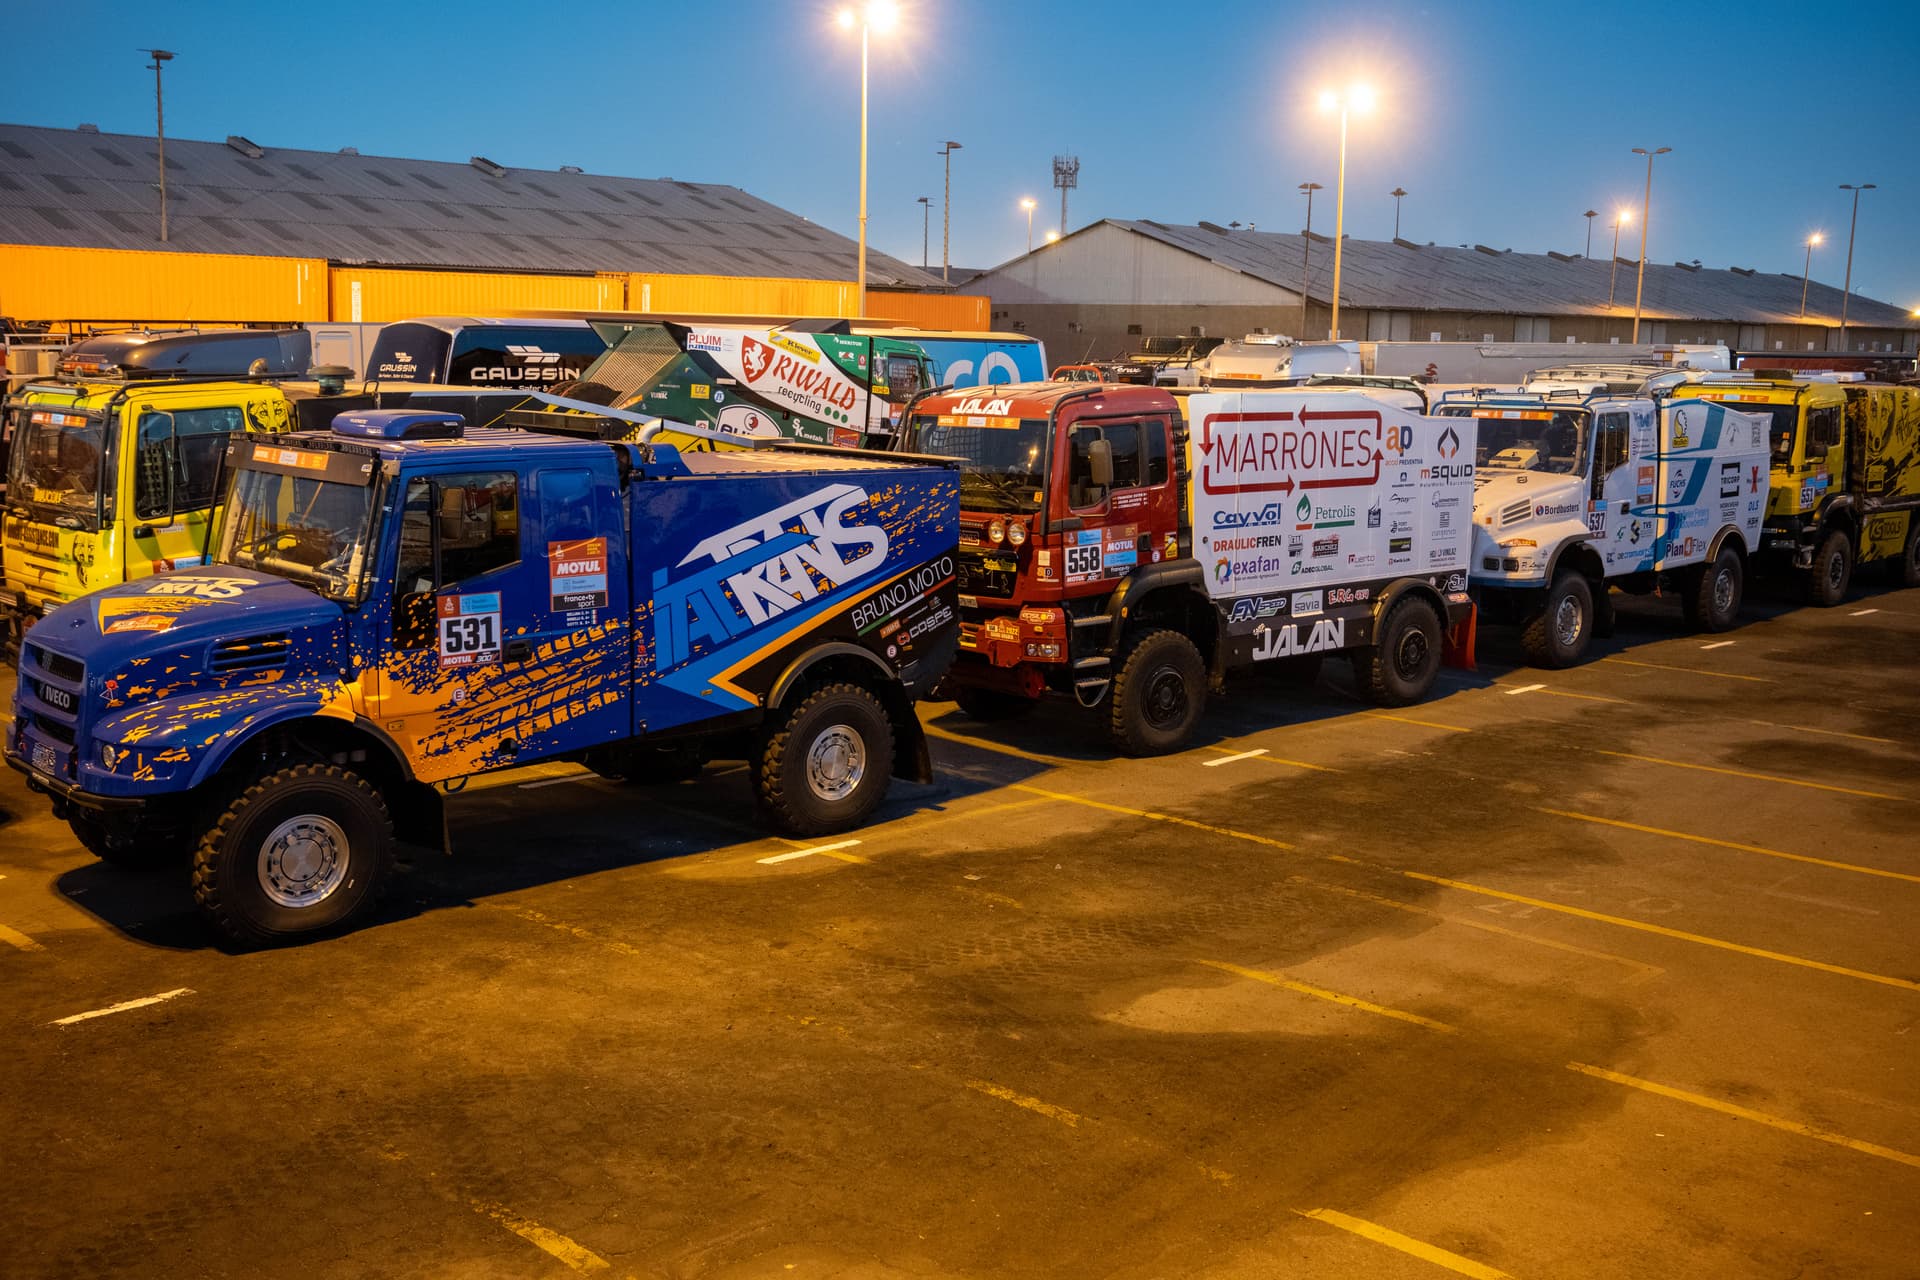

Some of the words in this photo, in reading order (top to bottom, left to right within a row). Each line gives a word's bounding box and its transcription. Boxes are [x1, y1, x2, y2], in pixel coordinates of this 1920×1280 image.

[689, 334, 722, 346] PLUIM
[772, 354, 857, 411] RIWALD
[777, 385, 823, 414] recycling
[952, 398, 1014, 416] JALAN
[1217, 430, 1371, 473] MARRONES
[1670, 480, 1686, 488] FUCHS
[1720, 475, 1740, 484] TRICORP
[1315, 505, 1356, 519] Petrolis
[1544, 503, 1580, 515] Bordbusters
[1589, 512, 1605, 531] 537
[1107, 541, 1133, 552] MOTUL
[1213, 535, 1282, 552] DRAULICFREN
[557, 560, 601, 575] MOTUL
[1068, 546, 1100, 574] 558
[1233, 556, 1280, 575] exafan
[851, 584, 907, 630] BRUNO
[908, 556, 953, 596] MOTO
[578, 600, 595, 608] sport
[1294, 600, 1320, 611] savia
[909, 605, 952, 639] COSPE
[446, 616, 497, 653] 531
[1253, 617, 1345, 661] JALAN
[443, 655, 473, 666] MOTUL
[46, 685, 71, 709] IVECO
